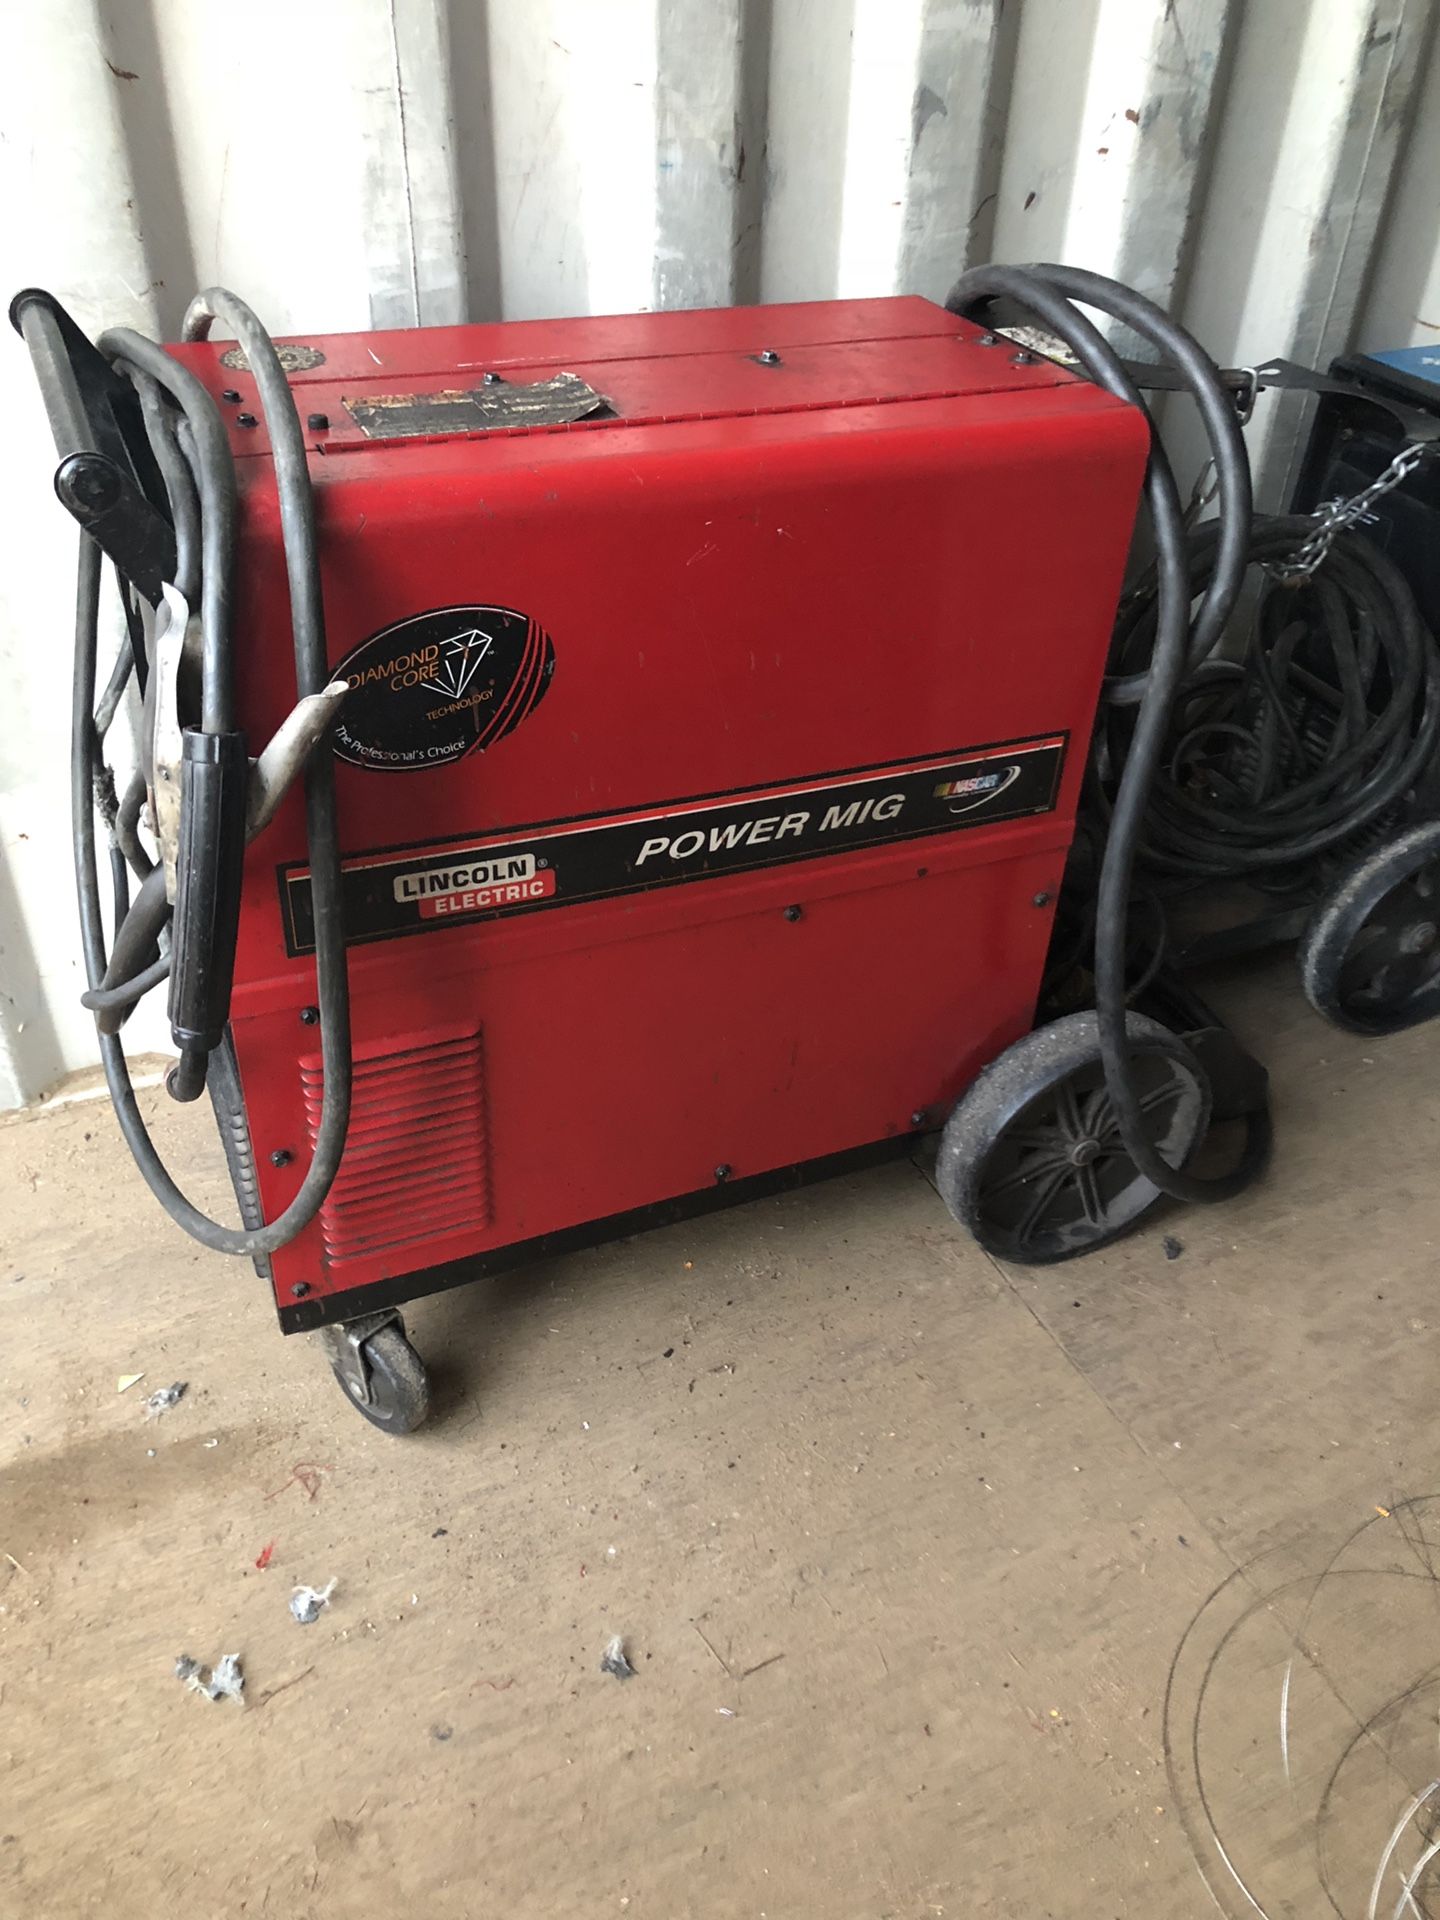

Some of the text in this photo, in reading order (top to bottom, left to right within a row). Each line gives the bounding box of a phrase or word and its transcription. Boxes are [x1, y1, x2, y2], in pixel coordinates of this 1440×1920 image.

[346, 644, 440, 690] DIAMOND
[390, 660, 440, 692] CORE
[426, 688, 495, 722] TECHNOLOGY
[336, 725, 466, 761] The Profesonal's Choice
[634, 793, 906, 866] POWER MIG
[403, 859, 527, 897] LINCOLN
[435, 881, 544, 914] ELECTRIC
